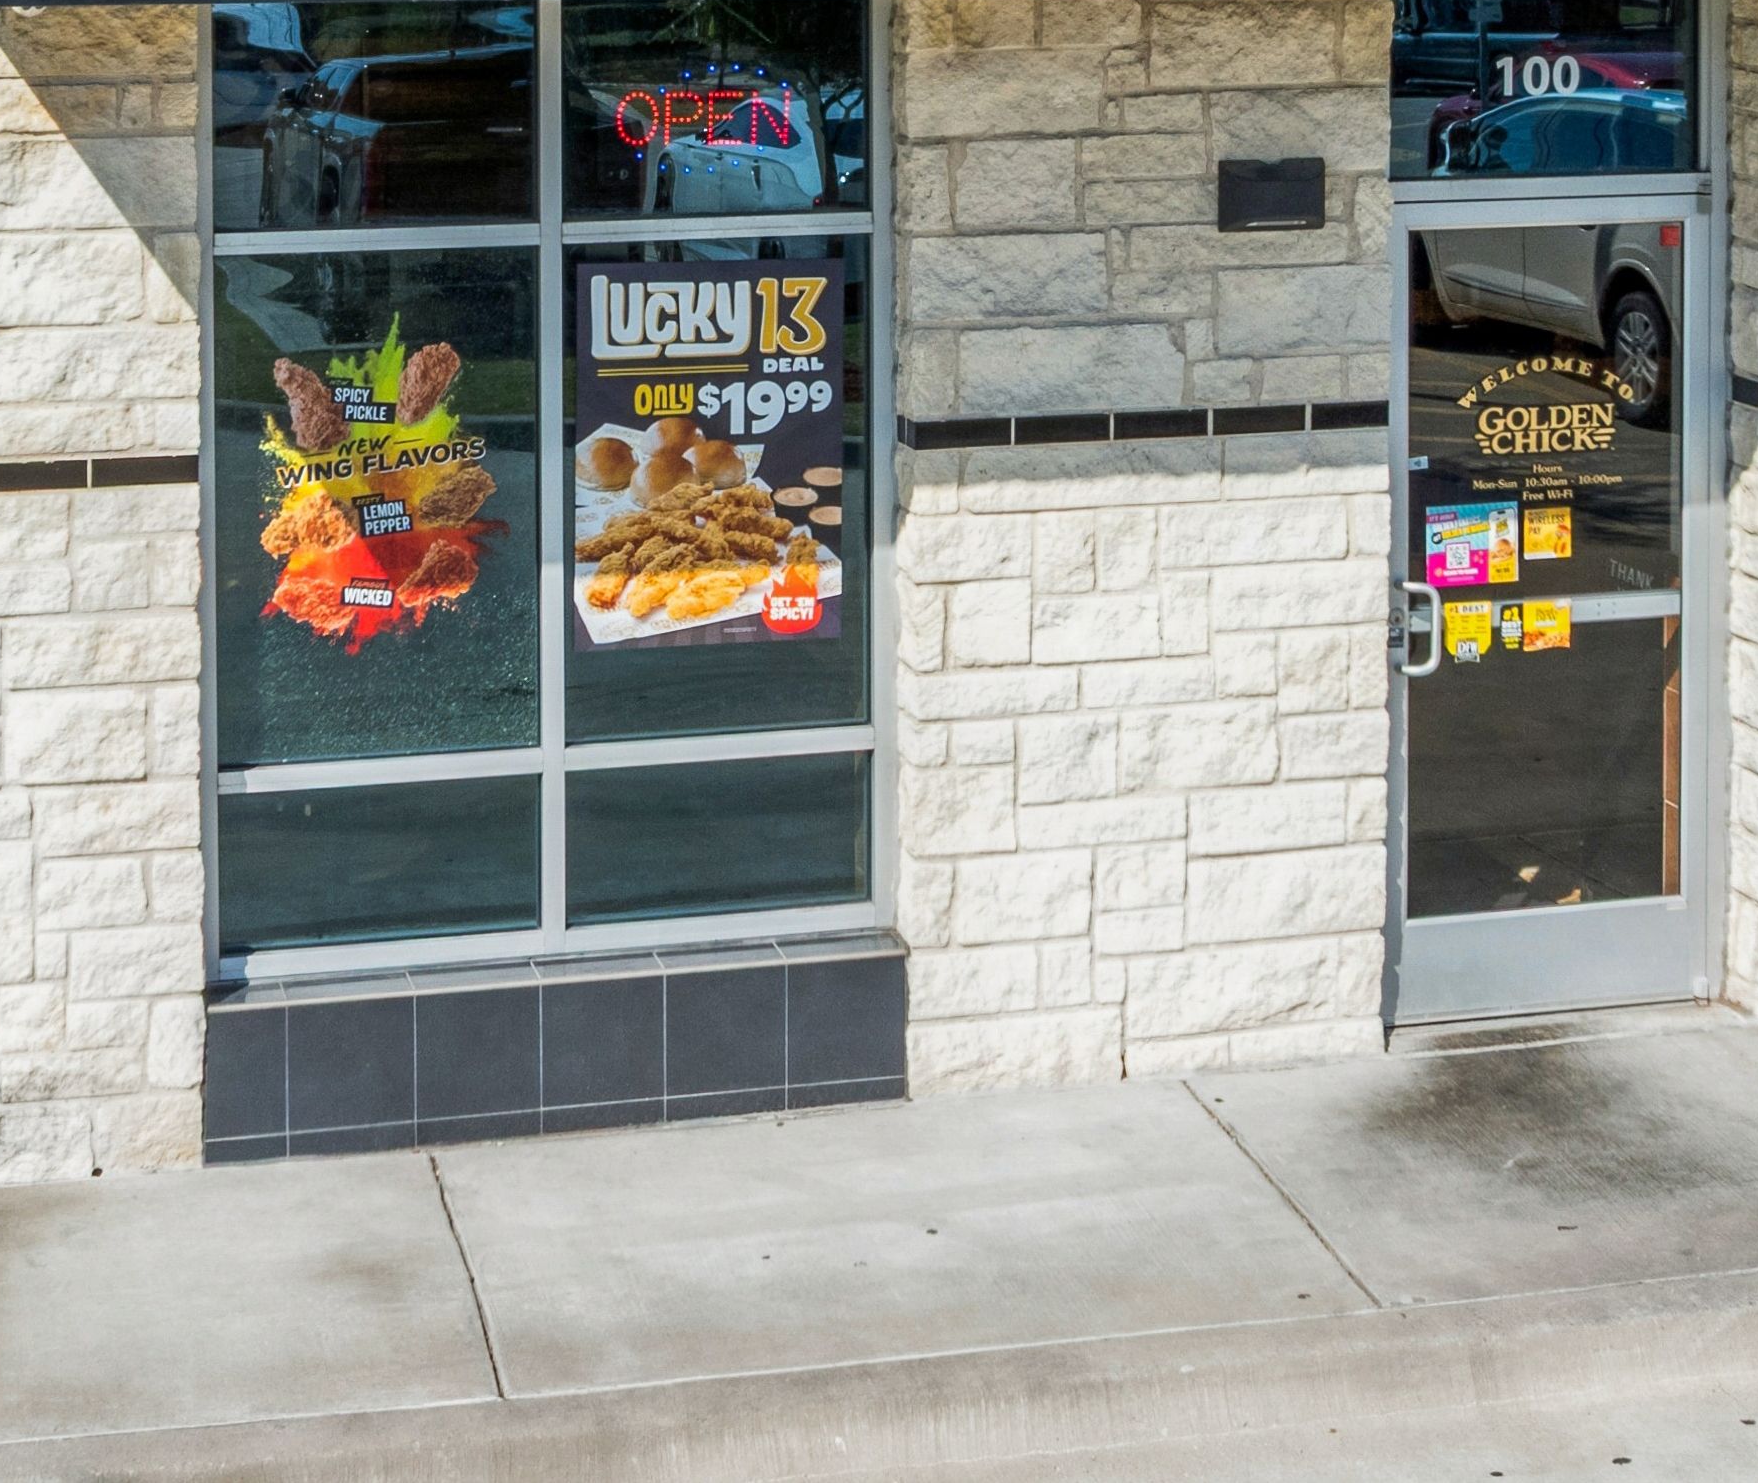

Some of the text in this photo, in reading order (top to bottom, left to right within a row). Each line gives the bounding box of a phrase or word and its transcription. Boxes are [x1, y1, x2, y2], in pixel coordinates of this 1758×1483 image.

[1496, 55, 1580, 96] 100
[616, 90, 791, 147] OPEN
[591, 275, 828, 360] LUCKY 13
[763, 357, 824, 373] DEAL
[1457, 357, 1634, 408] WELCOME TO
[334, 387, 370, 403] SPICY
[634, 383, 694, 416] ONLY
[345, 405, 387, 421] PICKLE
[1478, 403, 1615, 435] GOLDEN
[338, 436, 391, 457] NEW
[1492, 428, 1599, 454] CHICK
[277, 438, 486, 488] WING FLAVORS
[1532, 463, 1563, 473] Hours
[1472, 479, 1518, 490] Mon-Sun
[1524, 477, 1568, 487] 10:30am
[1578, 474, 1623, 485] 10:00pm
[1522, 489, 1574, 501] Free Wi-Fi
[363, 501, 403, 519] LEMON
[1528, 514, 1565, 525] WIRELESS
[365, 516, 410, 536] PEPPER
[1609, 558, 1654, 590] THANK
[344, 587, 393, 606] WICKED
[770, 597, 791, 608] GET
[770, 607, 815, 621] SPICY!
